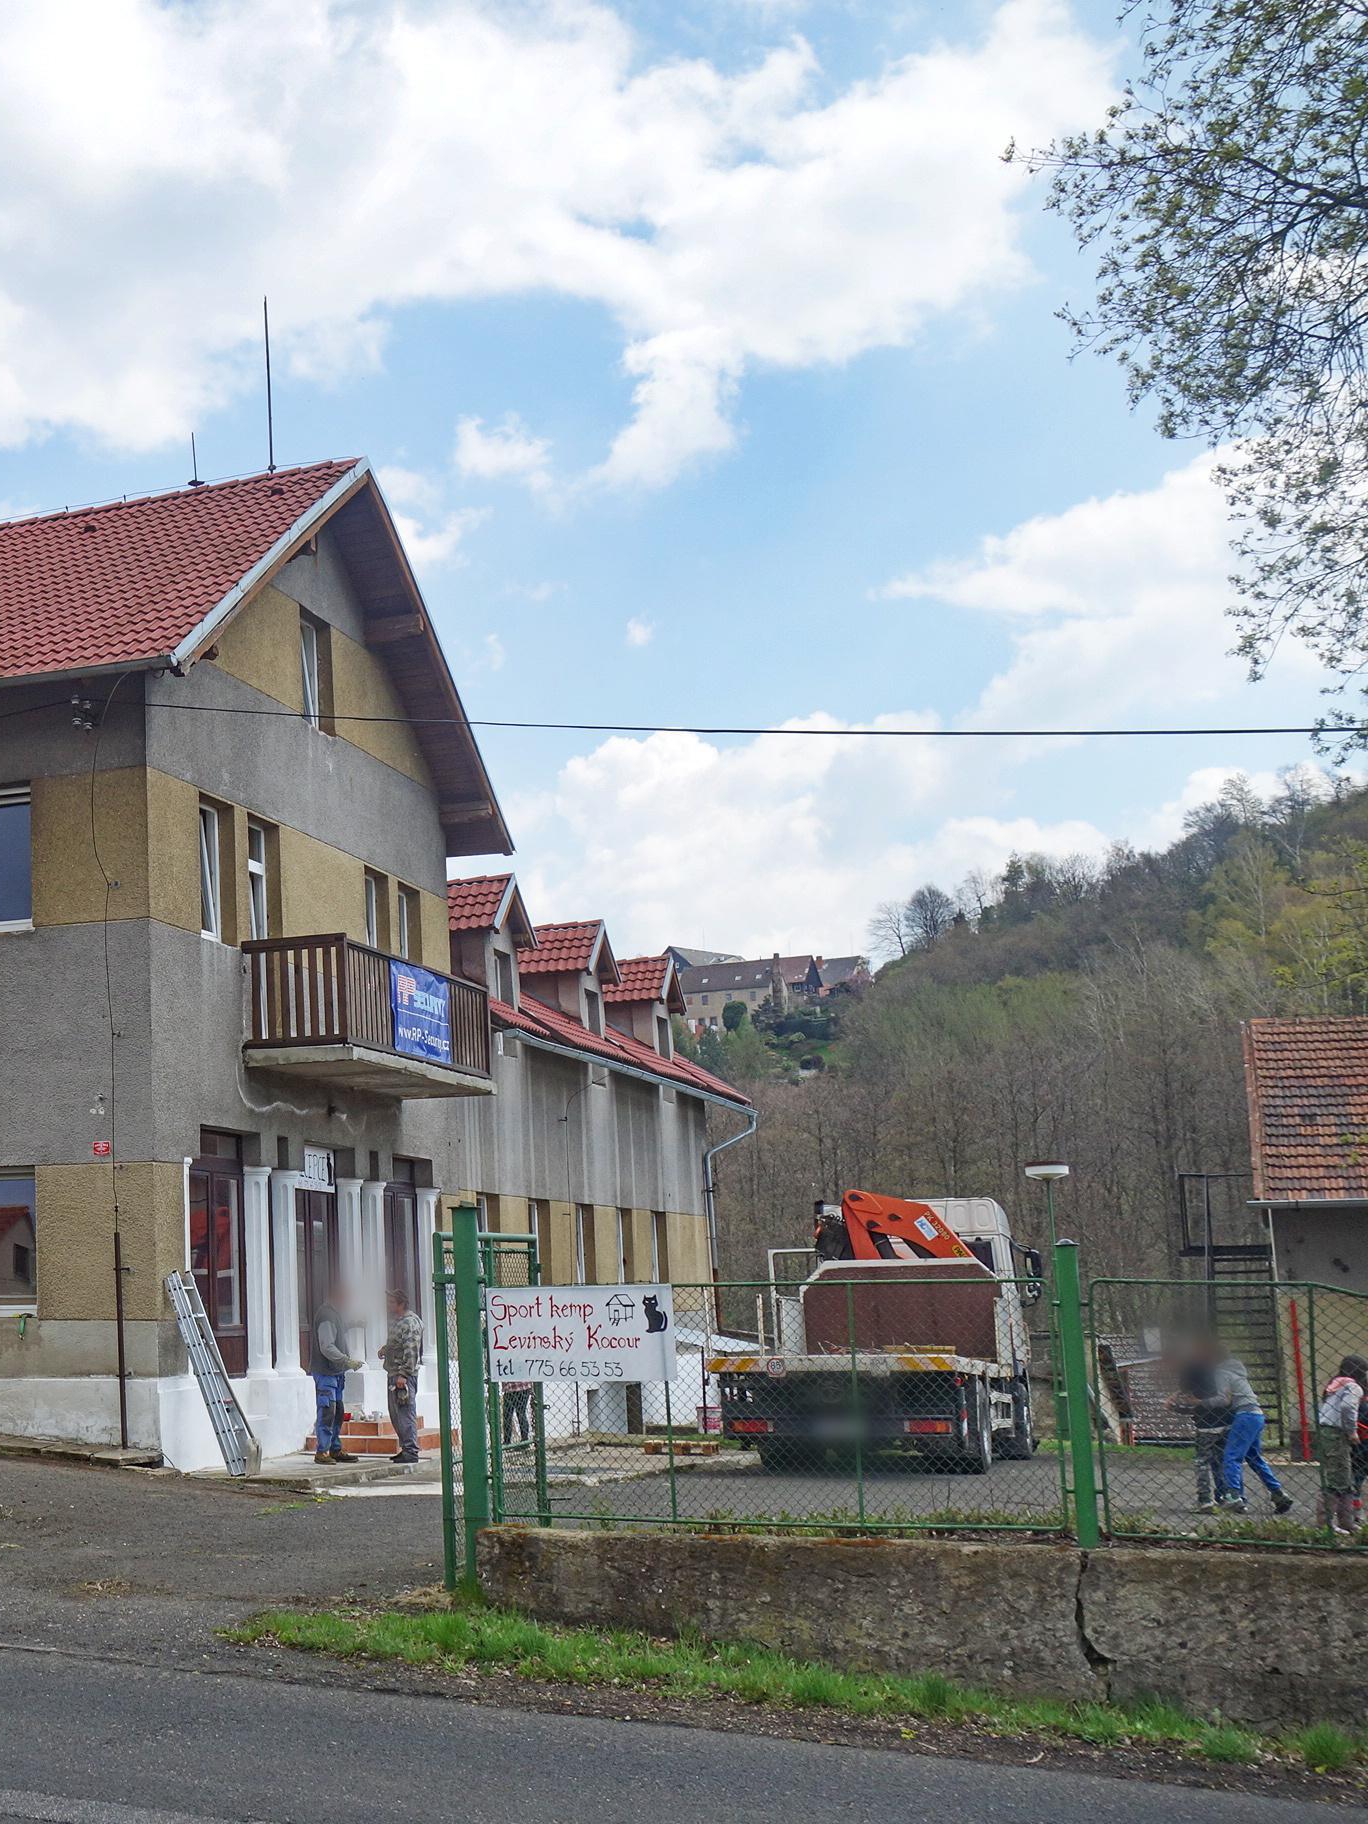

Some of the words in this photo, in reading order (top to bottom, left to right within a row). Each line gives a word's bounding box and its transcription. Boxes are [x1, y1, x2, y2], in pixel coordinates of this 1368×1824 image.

[490, 1295, 542, 1326] Sport
[549, 1294, 594, 1324] kemp
[586, 1323, 641, 1351] Kocour
[525, 1359, 555, 1377] 775
[559, 1360, 577, 1377] 66
[580, 1361, 601, 1377] 53
[604, 1361, 624, 1377] 53
